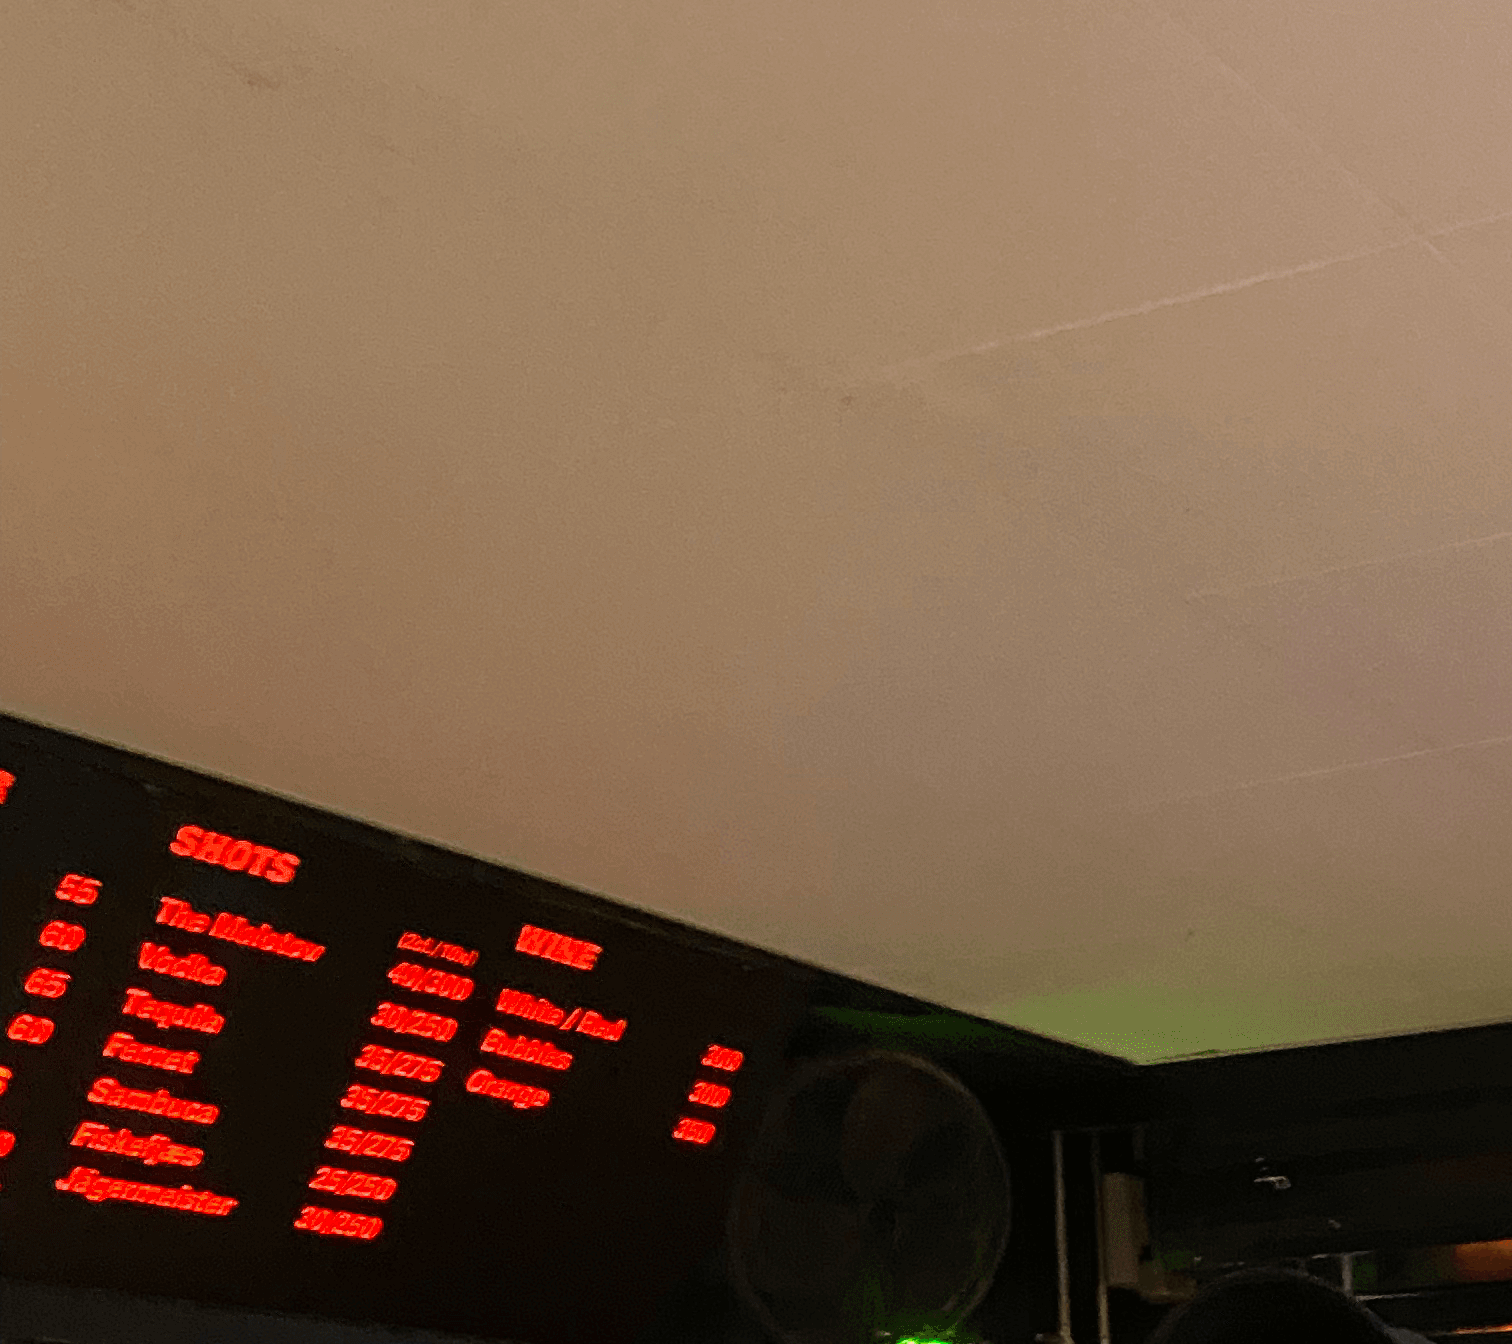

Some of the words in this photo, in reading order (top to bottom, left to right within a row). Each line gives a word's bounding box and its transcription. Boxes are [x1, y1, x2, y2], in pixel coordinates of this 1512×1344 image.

[169, 825, 300, 883] SHOTS
[55, 874, 102, 904] 55
[156, 896, 211, 932] The
[388, 962, 474, 1001] 40/300
[515, 924, 602, 970] WINE
[138, 942, 227, 986] Vodka
[370, 1002, 458, 1042] 30/250
[496, 989, 565, 1027] White
[576, 1010, 627, 1041] Red
[122, 988, 225, 1034] Tequila
[355, 1044, 445, 1082] 35/275
[480, 1027, 573, 1070] Bubbles
[102, 1032, 200, 1074] Fernet
[340, 1084, 431, 1122] 35/275
[465, 1068, 550, 1109] Orange
[87, 1077, 220, 1124] Sambuca
[324, 1125, 414, 1162] 35/275
[308, 1166, 398, 1201] 25/250
[294, 1206, 383, 1240] 30/250
